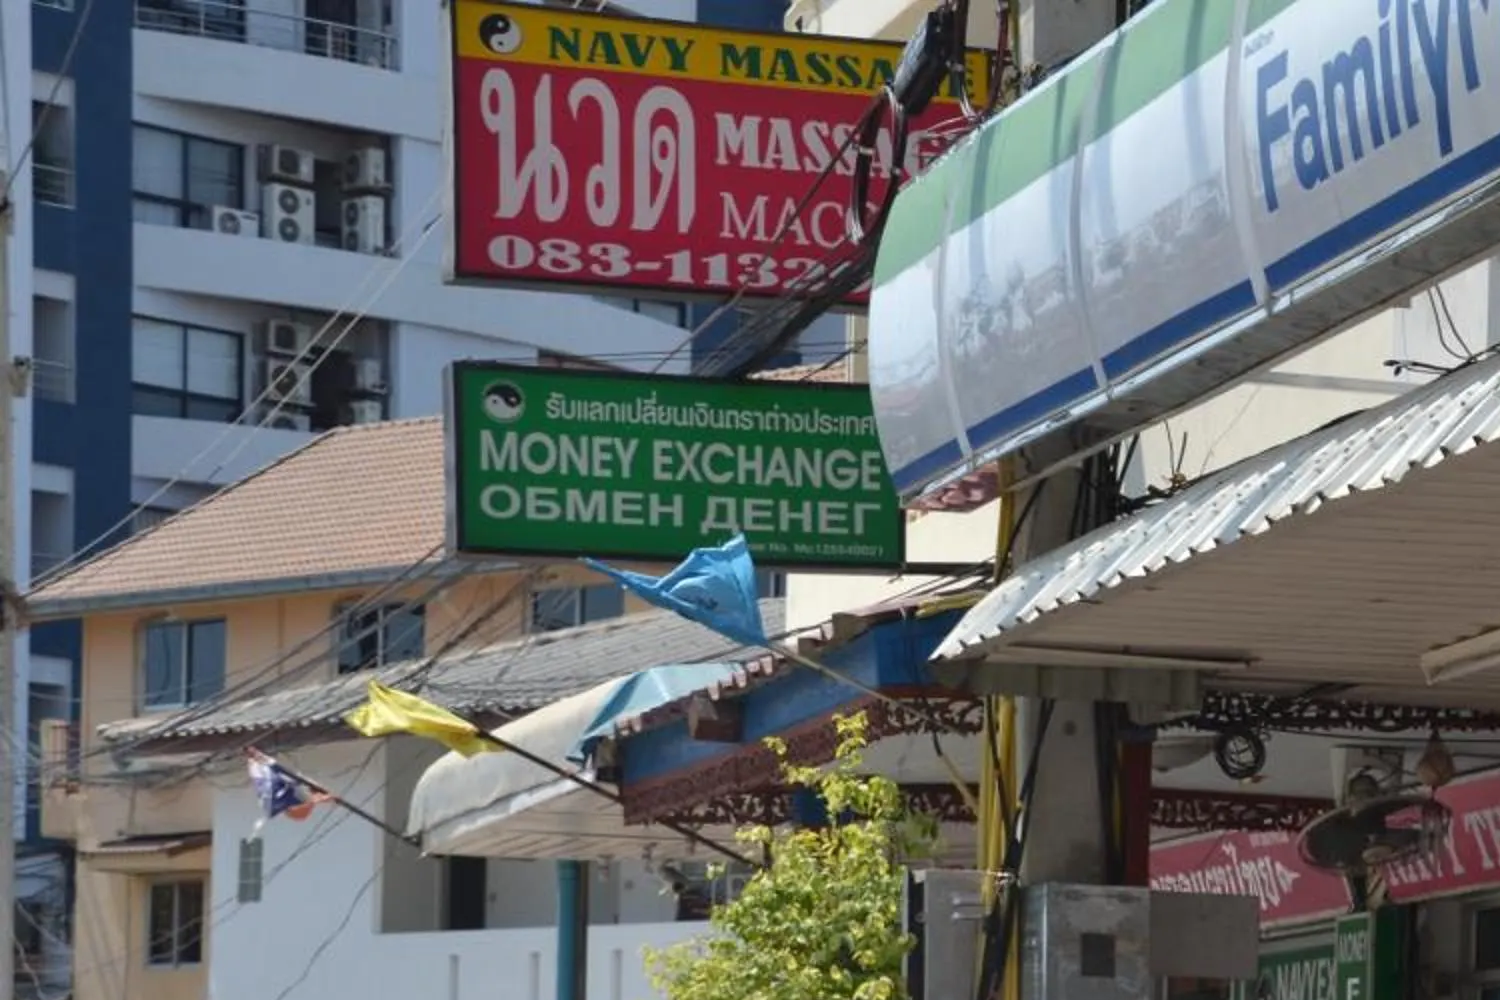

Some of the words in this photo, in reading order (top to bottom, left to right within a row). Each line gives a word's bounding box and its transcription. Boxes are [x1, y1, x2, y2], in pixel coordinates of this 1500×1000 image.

[547, 26, 695, 71] NAVY
[719, 42, 975, 99] MASSAE
[480, 67, 696, 234] นวด
[479, 428, 638, 481] MONEY
[652, 437, 882, 491] EXCHANGE
[479, 483, 684, 529] ОБМЕН
[700, 494, 882, 536] ДЕНЕГ
